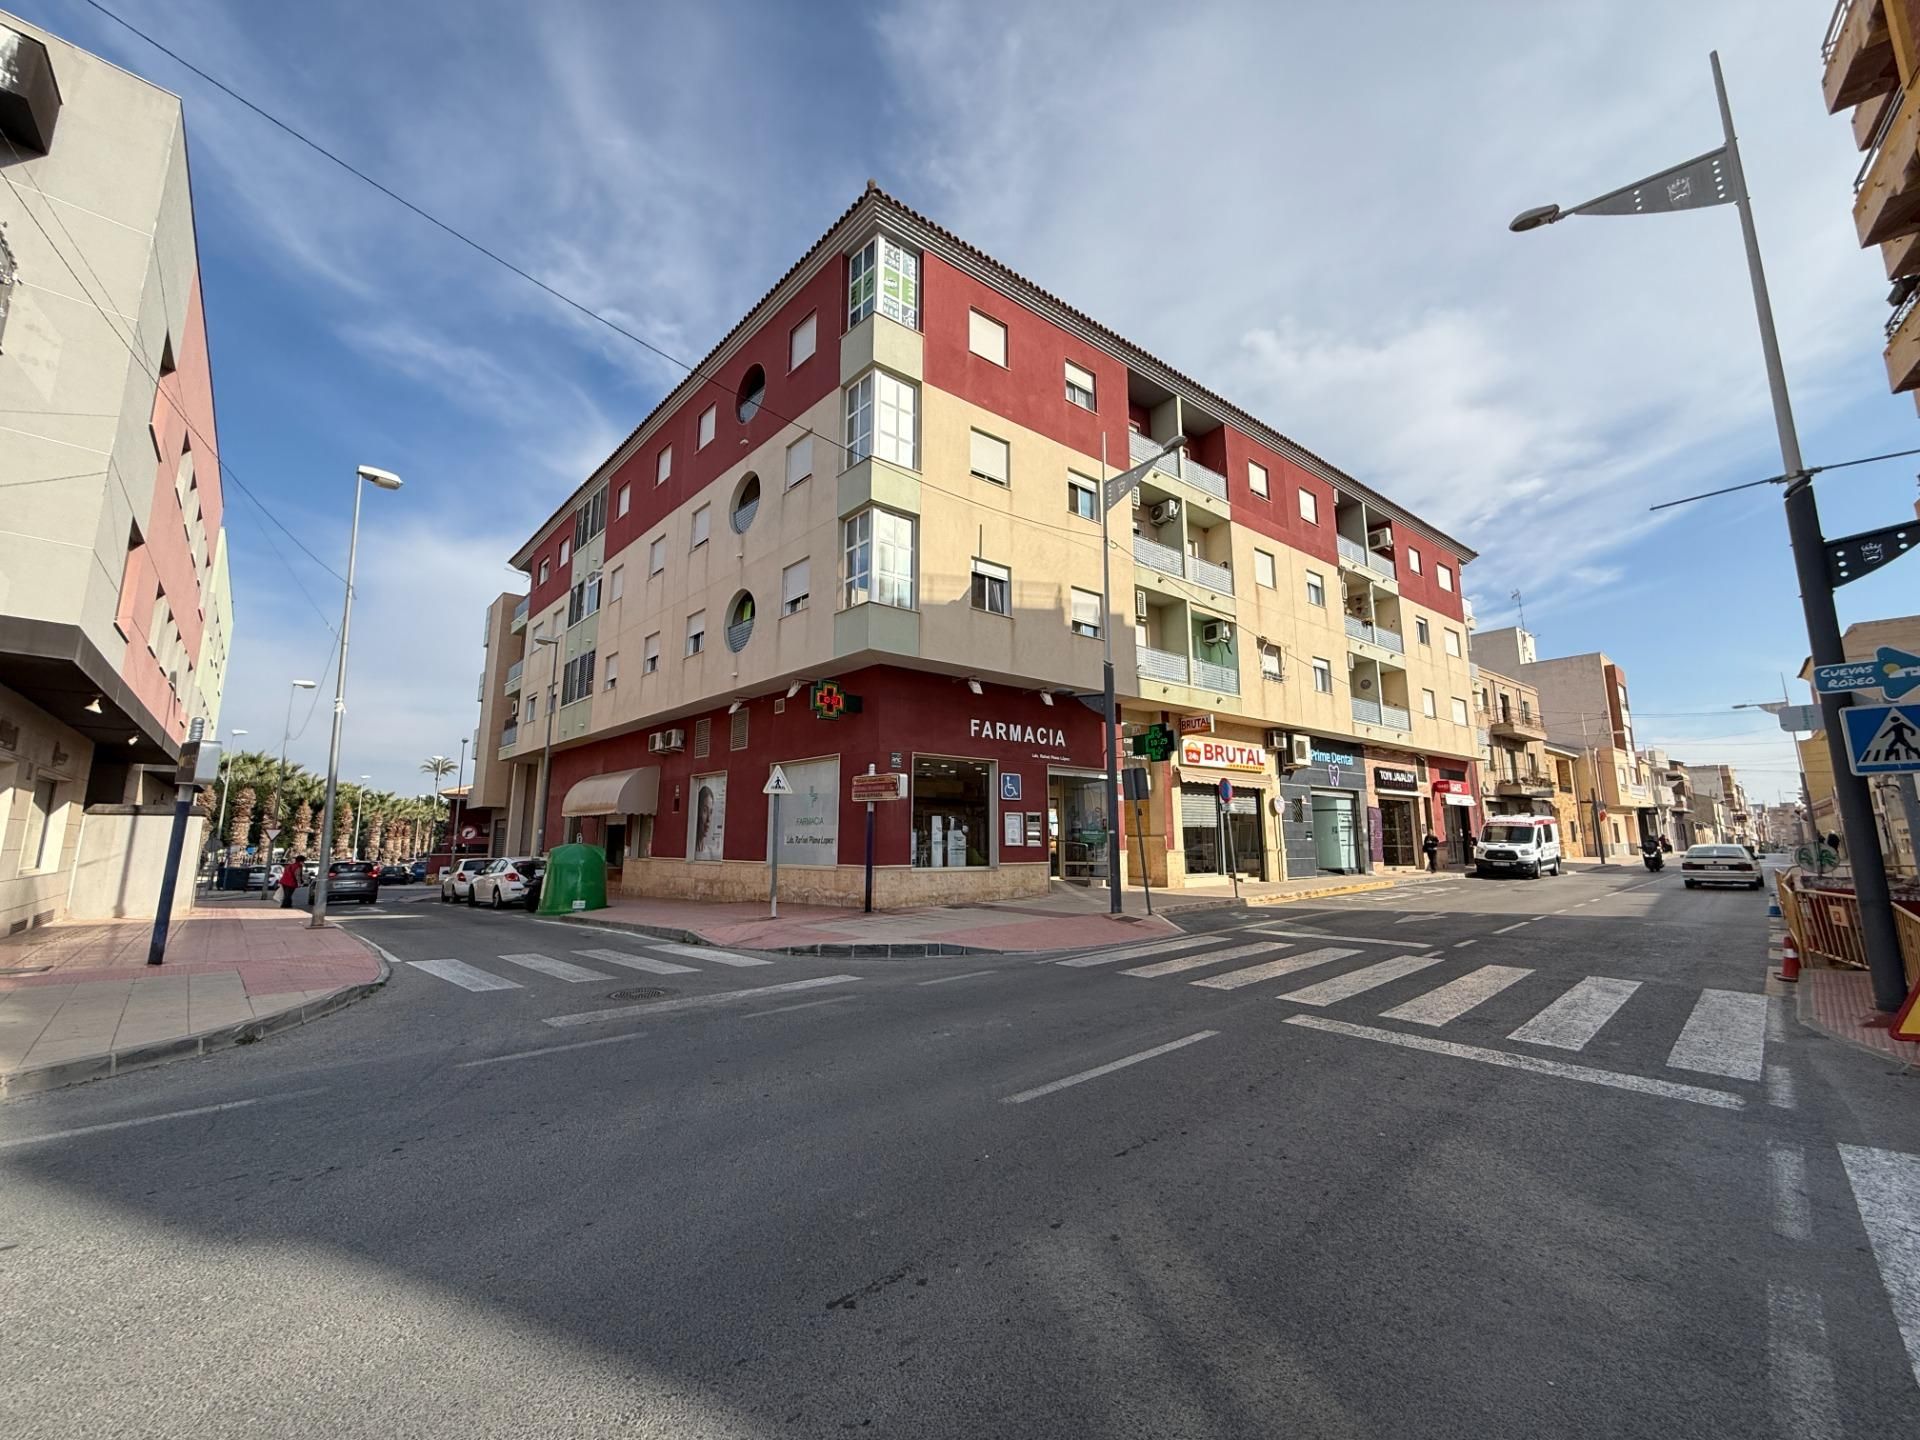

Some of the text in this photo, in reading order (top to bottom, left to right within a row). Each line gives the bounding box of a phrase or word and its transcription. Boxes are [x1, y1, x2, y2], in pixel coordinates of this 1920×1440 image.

[1820, 665, 1875, 678] CUEVAS
[1828, 676, 1876, 688] RODEO
[1181, 717, 1210, 730] BRUTAL
[970, 719, 1066, 747] FARMACIA
[1203, 743, 1265, 766] BRUTAL
[1310, 750, 1353, 766] Prime Dental
[1379, 770, 1392, 781] TONI
[795, 816, 824, 826] FARMACIA
